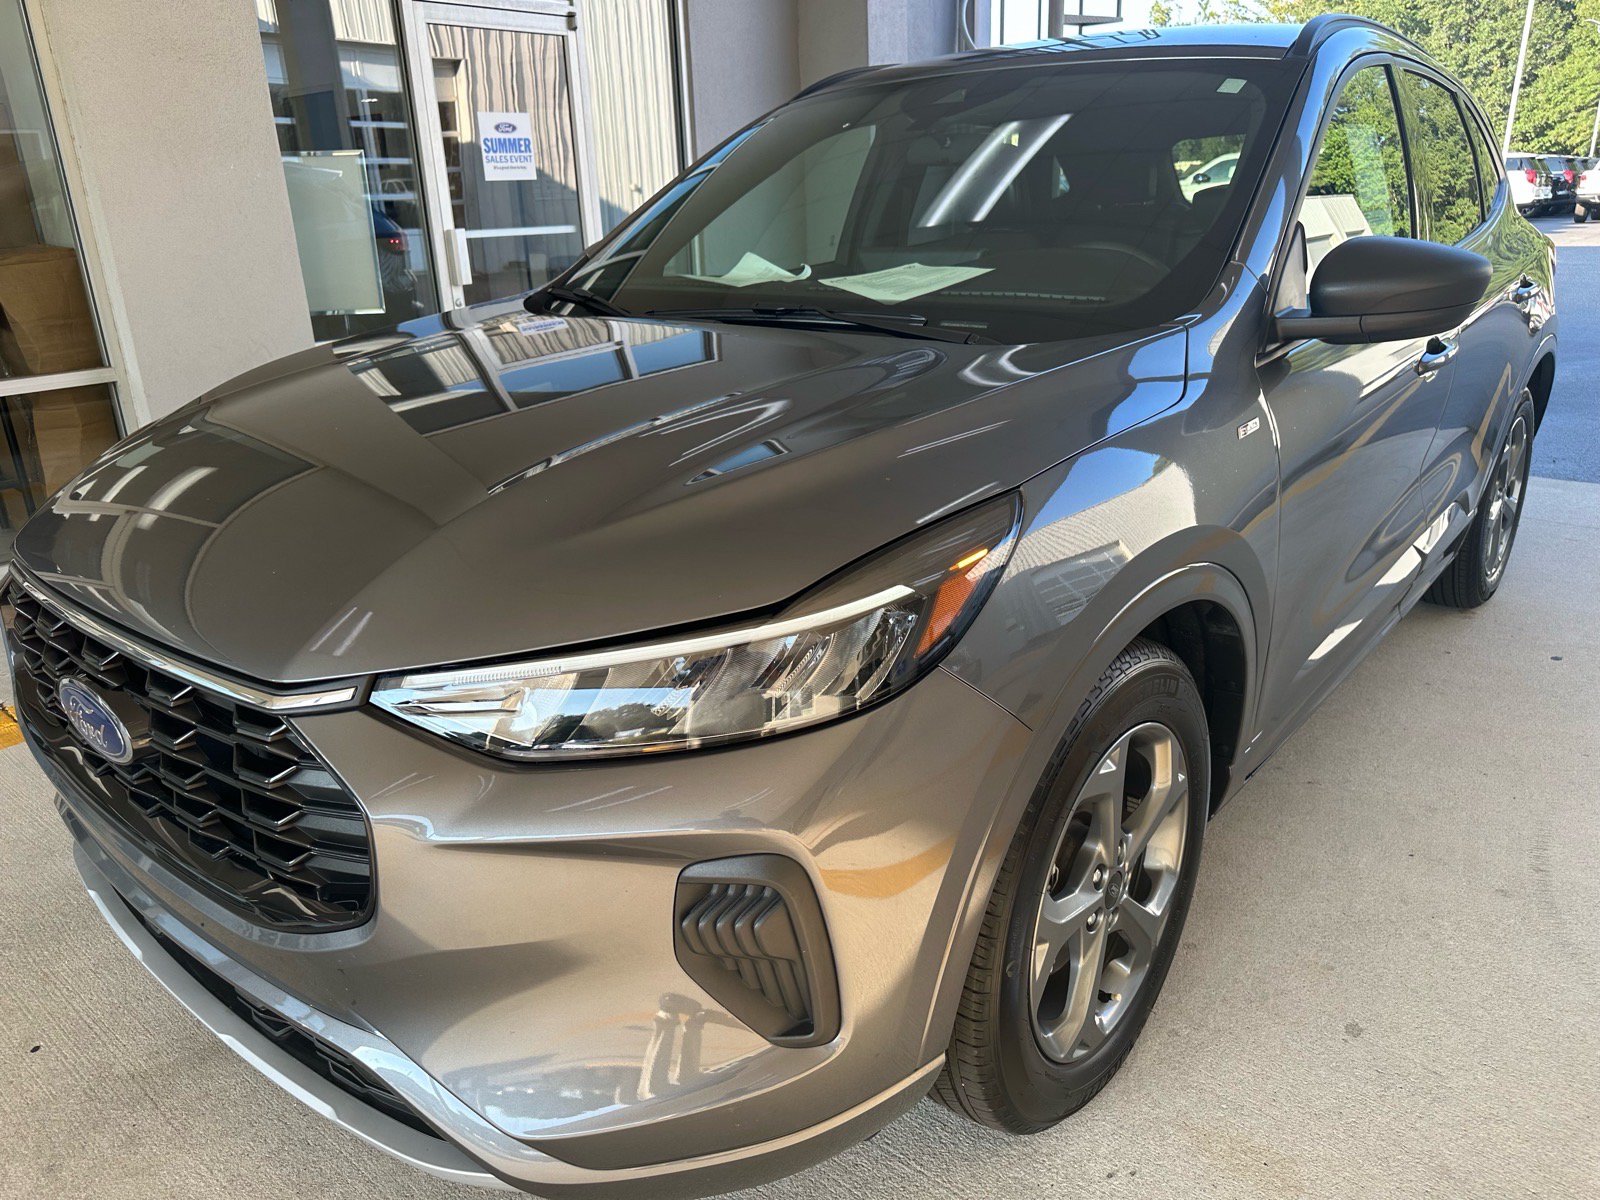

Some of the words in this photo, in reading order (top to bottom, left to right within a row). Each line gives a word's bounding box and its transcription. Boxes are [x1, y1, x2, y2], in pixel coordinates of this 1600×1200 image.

[483, 138, 532, 153] SUMMER
[485, 155, 509, 163] SALES
[510, 155, 532, 163] EVENT
[69, 695, 108, 748] Ford
